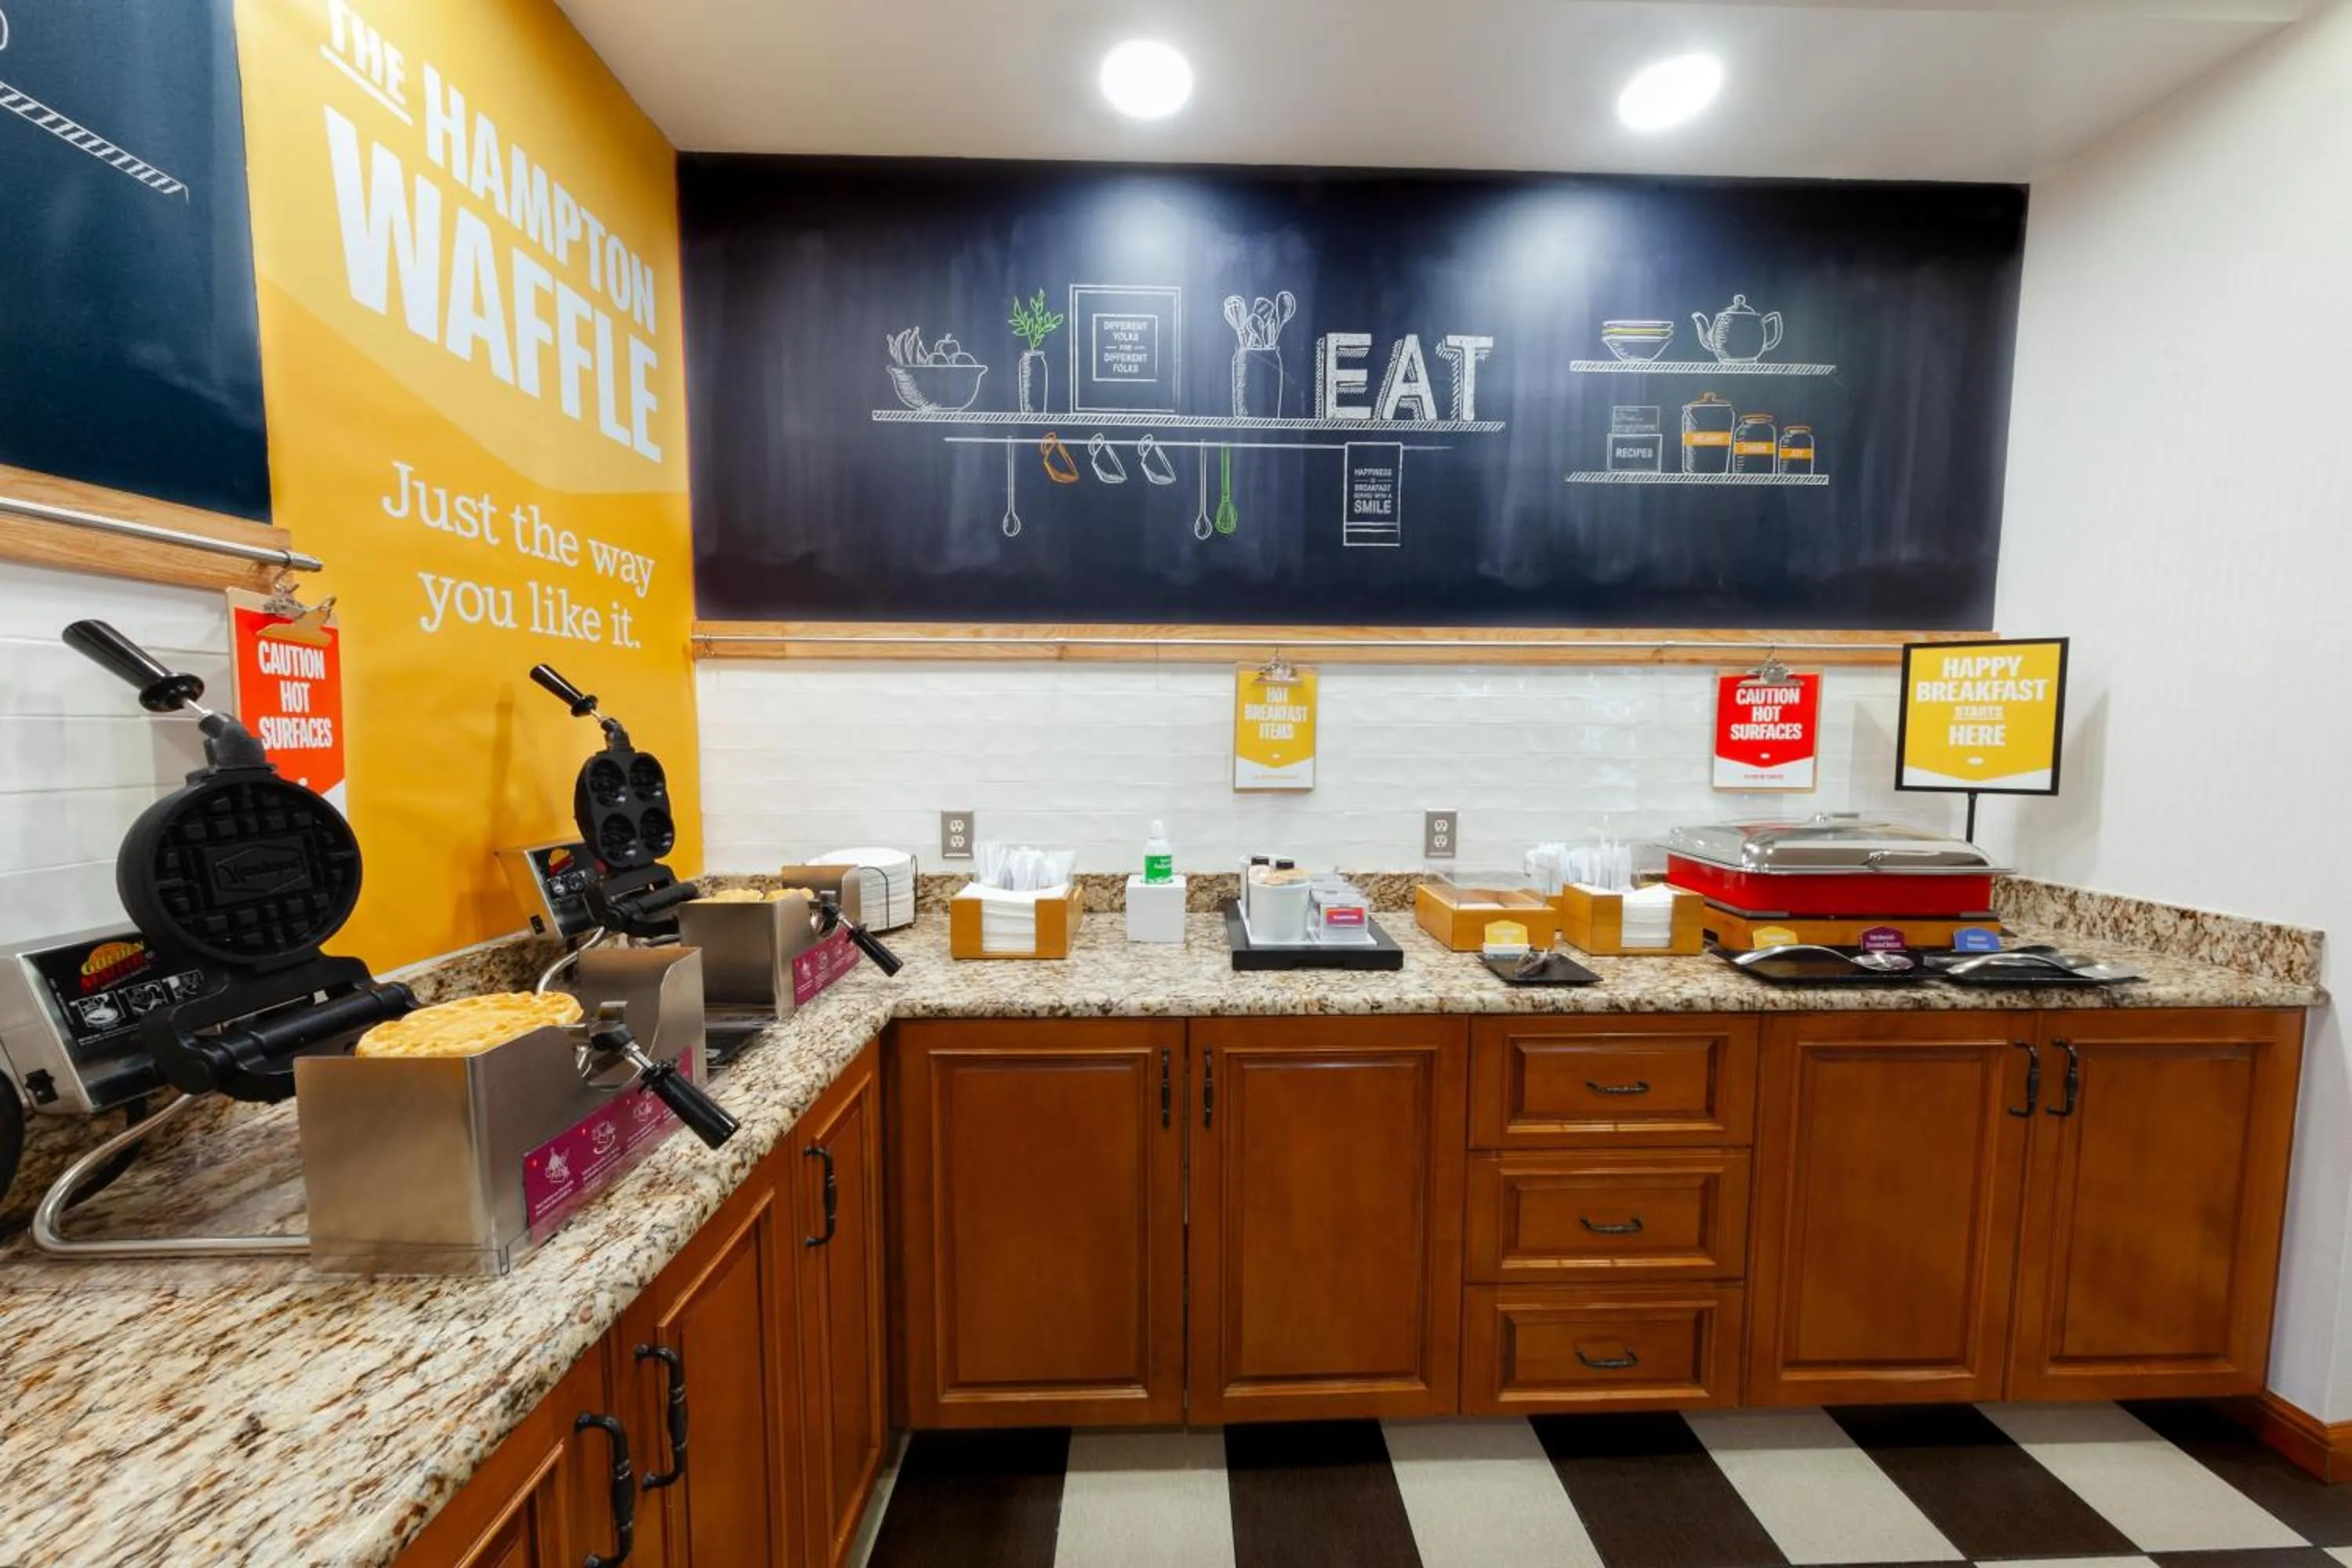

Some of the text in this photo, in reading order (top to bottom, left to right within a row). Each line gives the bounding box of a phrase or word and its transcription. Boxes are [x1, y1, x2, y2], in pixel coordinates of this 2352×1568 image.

[328, 0, 655, 334] THE HAMPTON
[324, 103, 662, 463] WAFFLE
[1315, 332, 1494, 421] EAT
[1616, 447, 1653, 459] RECIPES
[1354, 499, 1392, 514] SMILE
[381, 460, 656, 599] Just the way
[417, 571, 641, 649] you like it.
[258, 641, 325, 680] CAUTION
[1942, 655, 2024, 679] HAPPY
[279, 680, 311, 713] HOT
[1266, 687, 1288, 703] HOT
[1736, 688, 1801, 705] CAUTION
[1916, 679, 2049, 702] BREAKFAST
[1244, 702, 1308, 722] BREAKFAST
[1751, 706, 1782, 722] HOT
[258, 716, 333, 750] SURFACES
[1259, 723, 1294, 739] ITEMS
[1730, 723, 1802, 741] SURFACES
[1948, 723, 2007, 746] HERE
